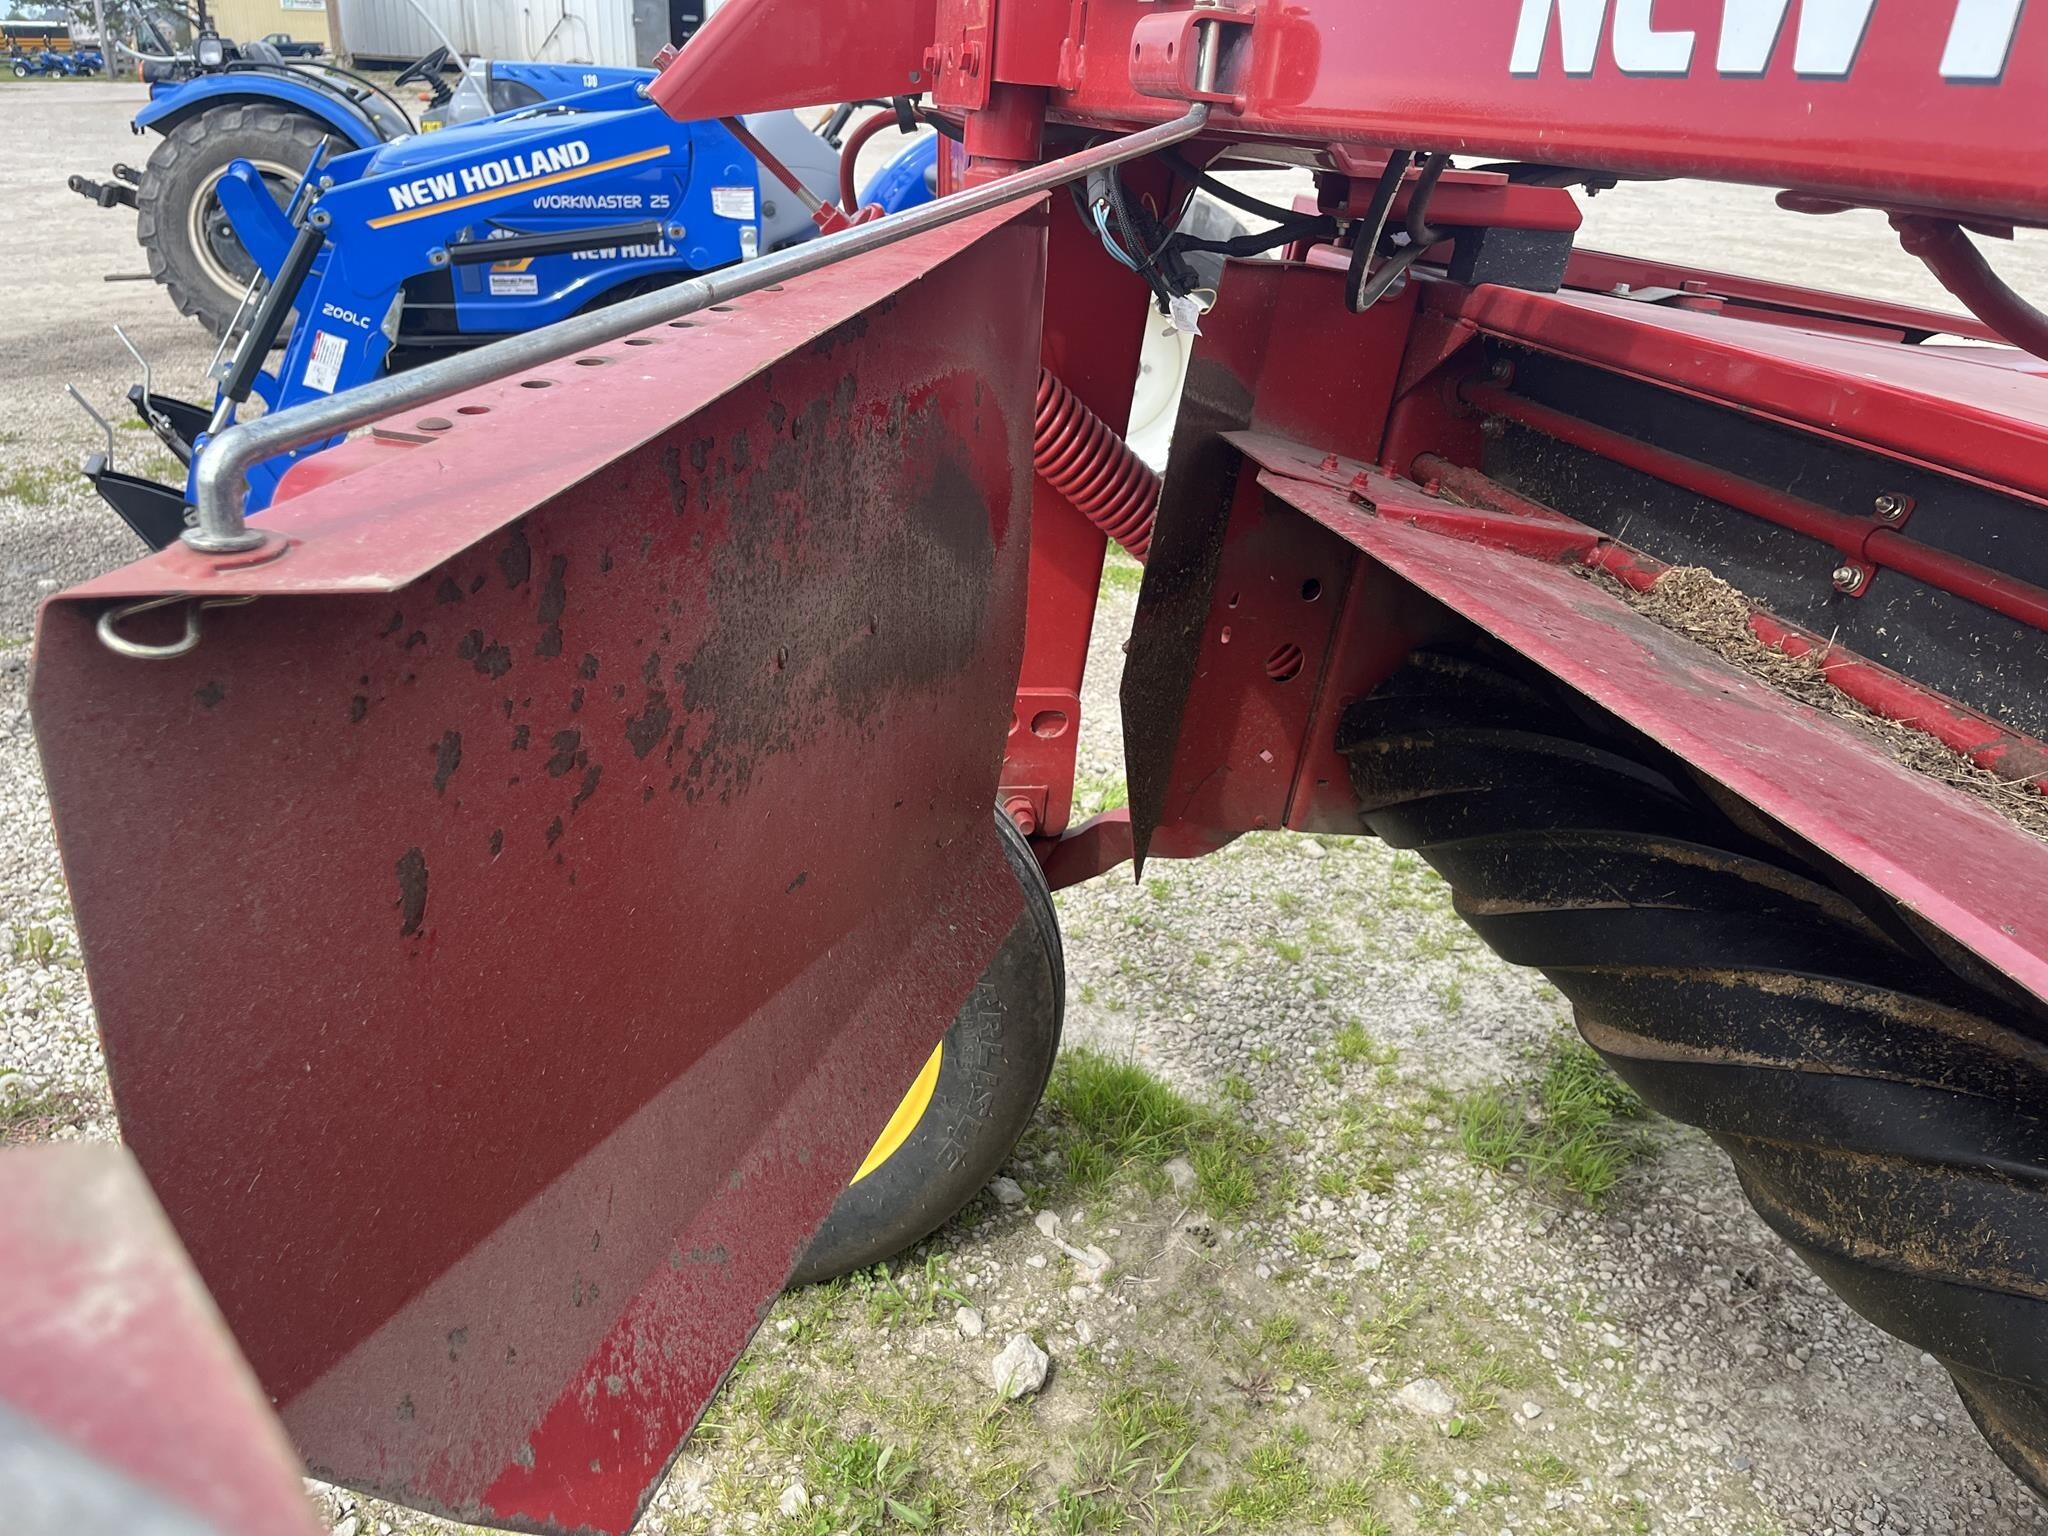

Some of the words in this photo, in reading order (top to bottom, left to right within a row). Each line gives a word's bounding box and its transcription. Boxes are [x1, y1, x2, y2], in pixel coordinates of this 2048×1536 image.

[388, 172, 457, 211] NEW
[460, 140, 590, 193] HOLLAND
[533, 195, 642, 209] WORKMASTER
[650, 195, 670, 208] 25
[621, 239, 678, 258] HOLLA
[322, 302, 371, 329] 200LC
[936, 966, 1004, 1172] ARLISLE
